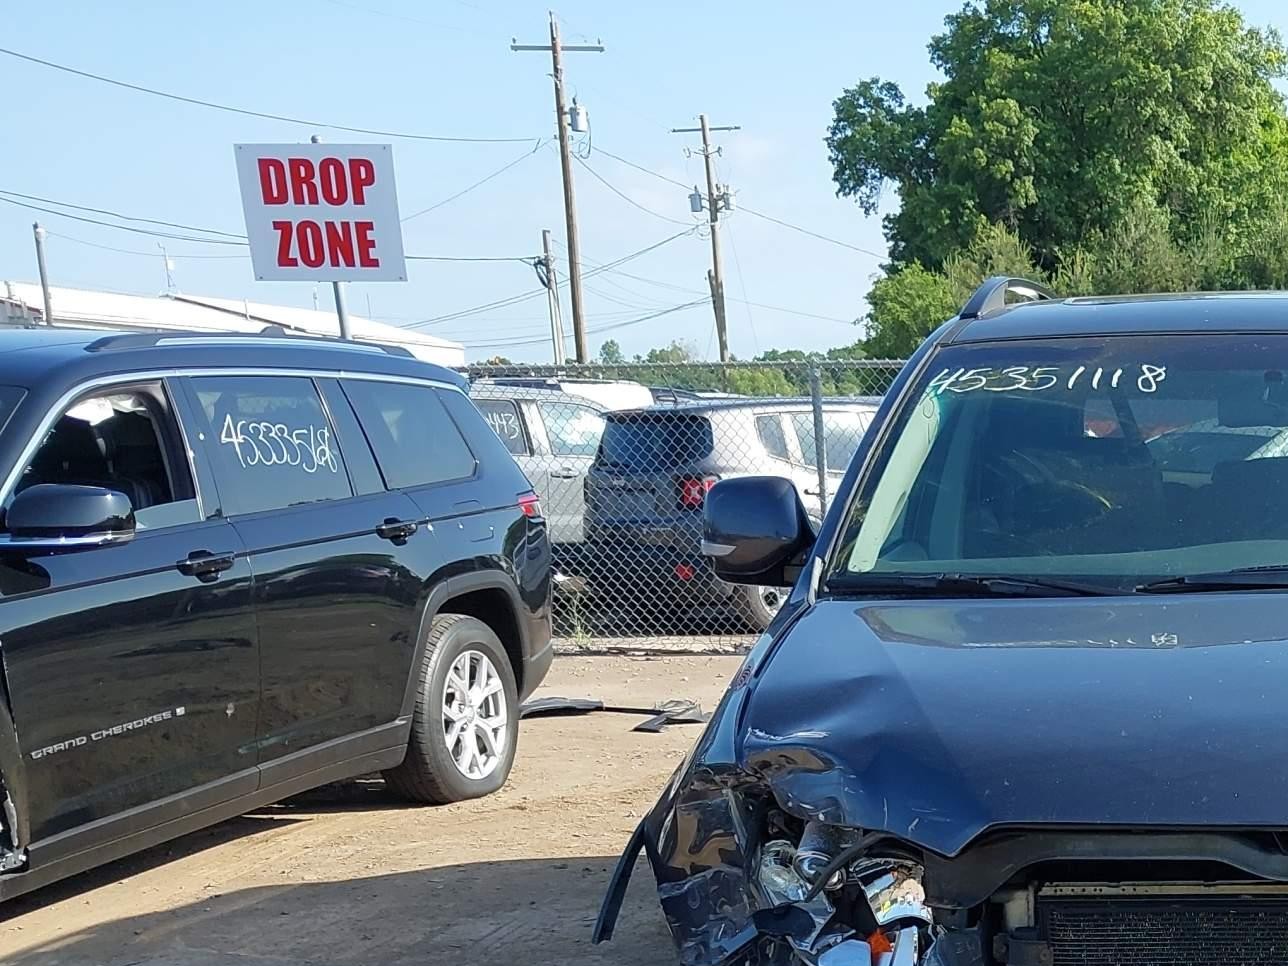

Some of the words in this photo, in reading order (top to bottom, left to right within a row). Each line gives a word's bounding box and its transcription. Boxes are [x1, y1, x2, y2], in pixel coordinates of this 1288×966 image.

[257, 157, 376, 206] DROP
[272, 219, 380, 269] ZONE
[928, 364, 1167, 395] 45351118
[30, 736, 88, 760] GRAND
[90, 710, 173, 741] CHEROKEE
